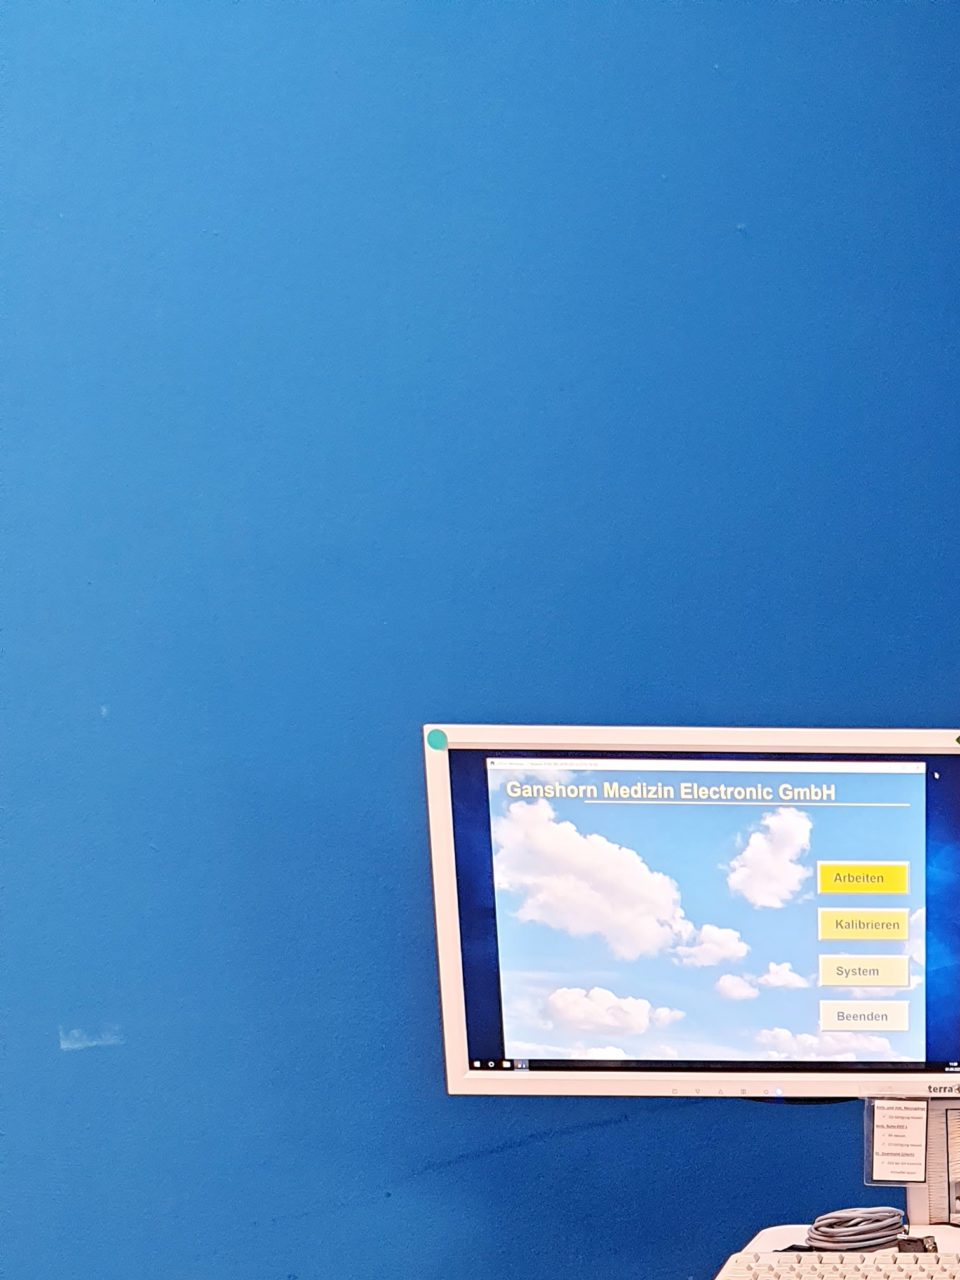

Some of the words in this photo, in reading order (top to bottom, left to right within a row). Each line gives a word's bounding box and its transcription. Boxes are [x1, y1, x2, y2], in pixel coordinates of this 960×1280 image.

[506, 780, 598, 798] Ganshorn
[603, 781, 674, 799] Medizin
[680, 782, 774, 800] Electronic
[778, 783, 836, 801] GmbH
[834, 872, 884, 884] Arbeiten
[835, 919, 900, 931] Kalibrieren
[836, 966, 880, 979] System
[837, 1011, 888, 1022] Beenden
[928, 1085, 953, 1093] terra
